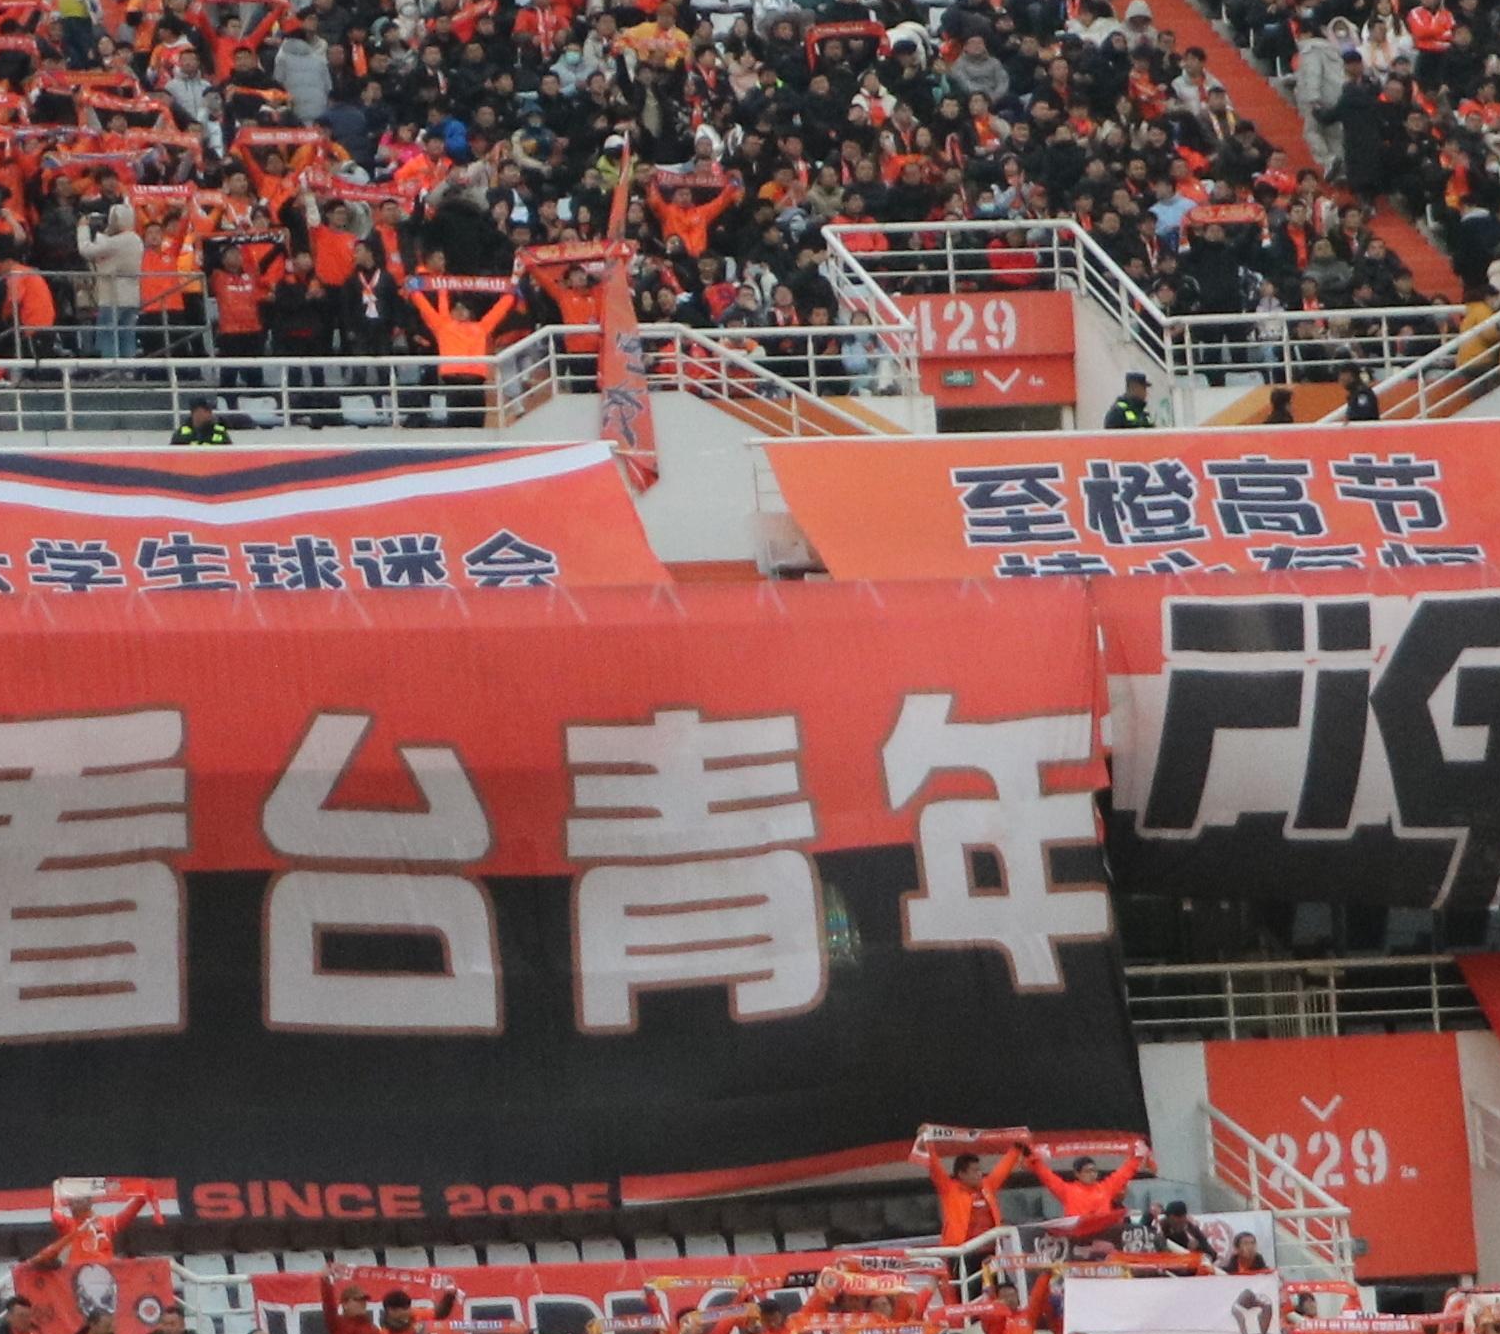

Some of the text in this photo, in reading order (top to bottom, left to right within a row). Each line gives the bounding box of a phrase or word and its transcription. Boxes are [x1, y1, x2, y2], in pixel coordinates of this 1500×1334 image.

[949, 454, 1449, 547] 至橙高节
[193, 1181, 425, 1221] SINCE
